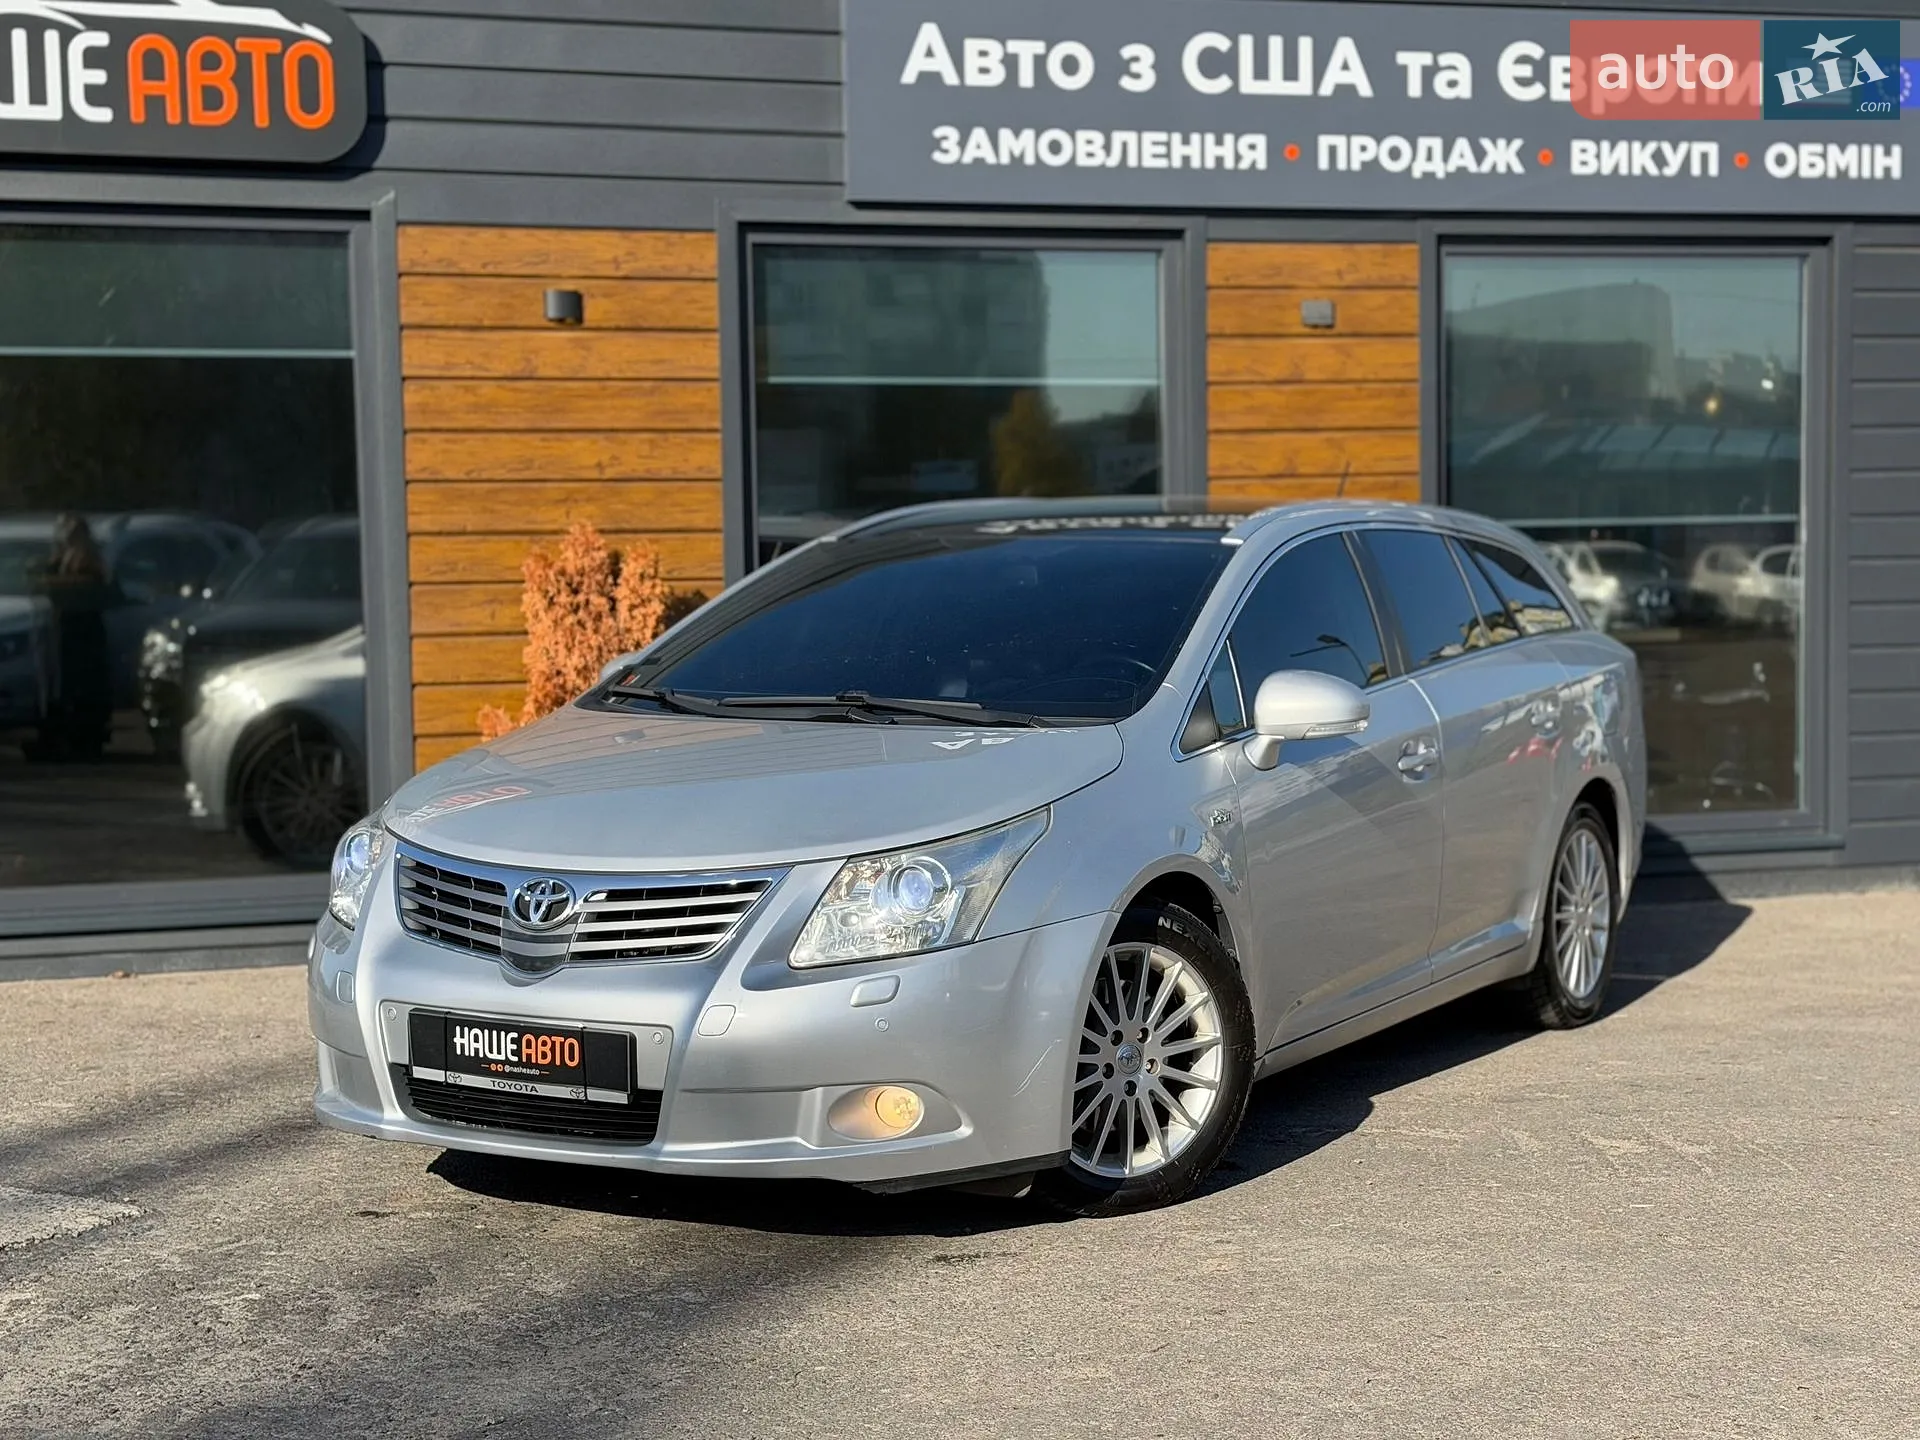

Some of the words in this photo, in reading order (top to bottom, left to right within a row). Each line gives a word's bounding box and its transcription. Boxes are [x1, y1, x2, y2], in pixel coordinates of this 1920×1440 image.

[127, 33, 336, 129] АВТО
[900, 22, 1095, 91] Авто
[1118, 43, 1157, 92] з
[1181, 31, 1374, 97] США
[1395, 51, 1472, 99] та
[931, 126, 1267, 170] ЗАМОВЛЕННЯ
[1317, 135, 1525, 179] ПРОДАЖ
[1570, 139, 1719, 177] ВИКУП
[1764, 143, 1902, 179] ОБМІН
[453, 1025, 518, 1062] НАШЕ
[521, 1033, 580, 1067] АВТО
[490, 1080, 539, 1093] TOYOTA
